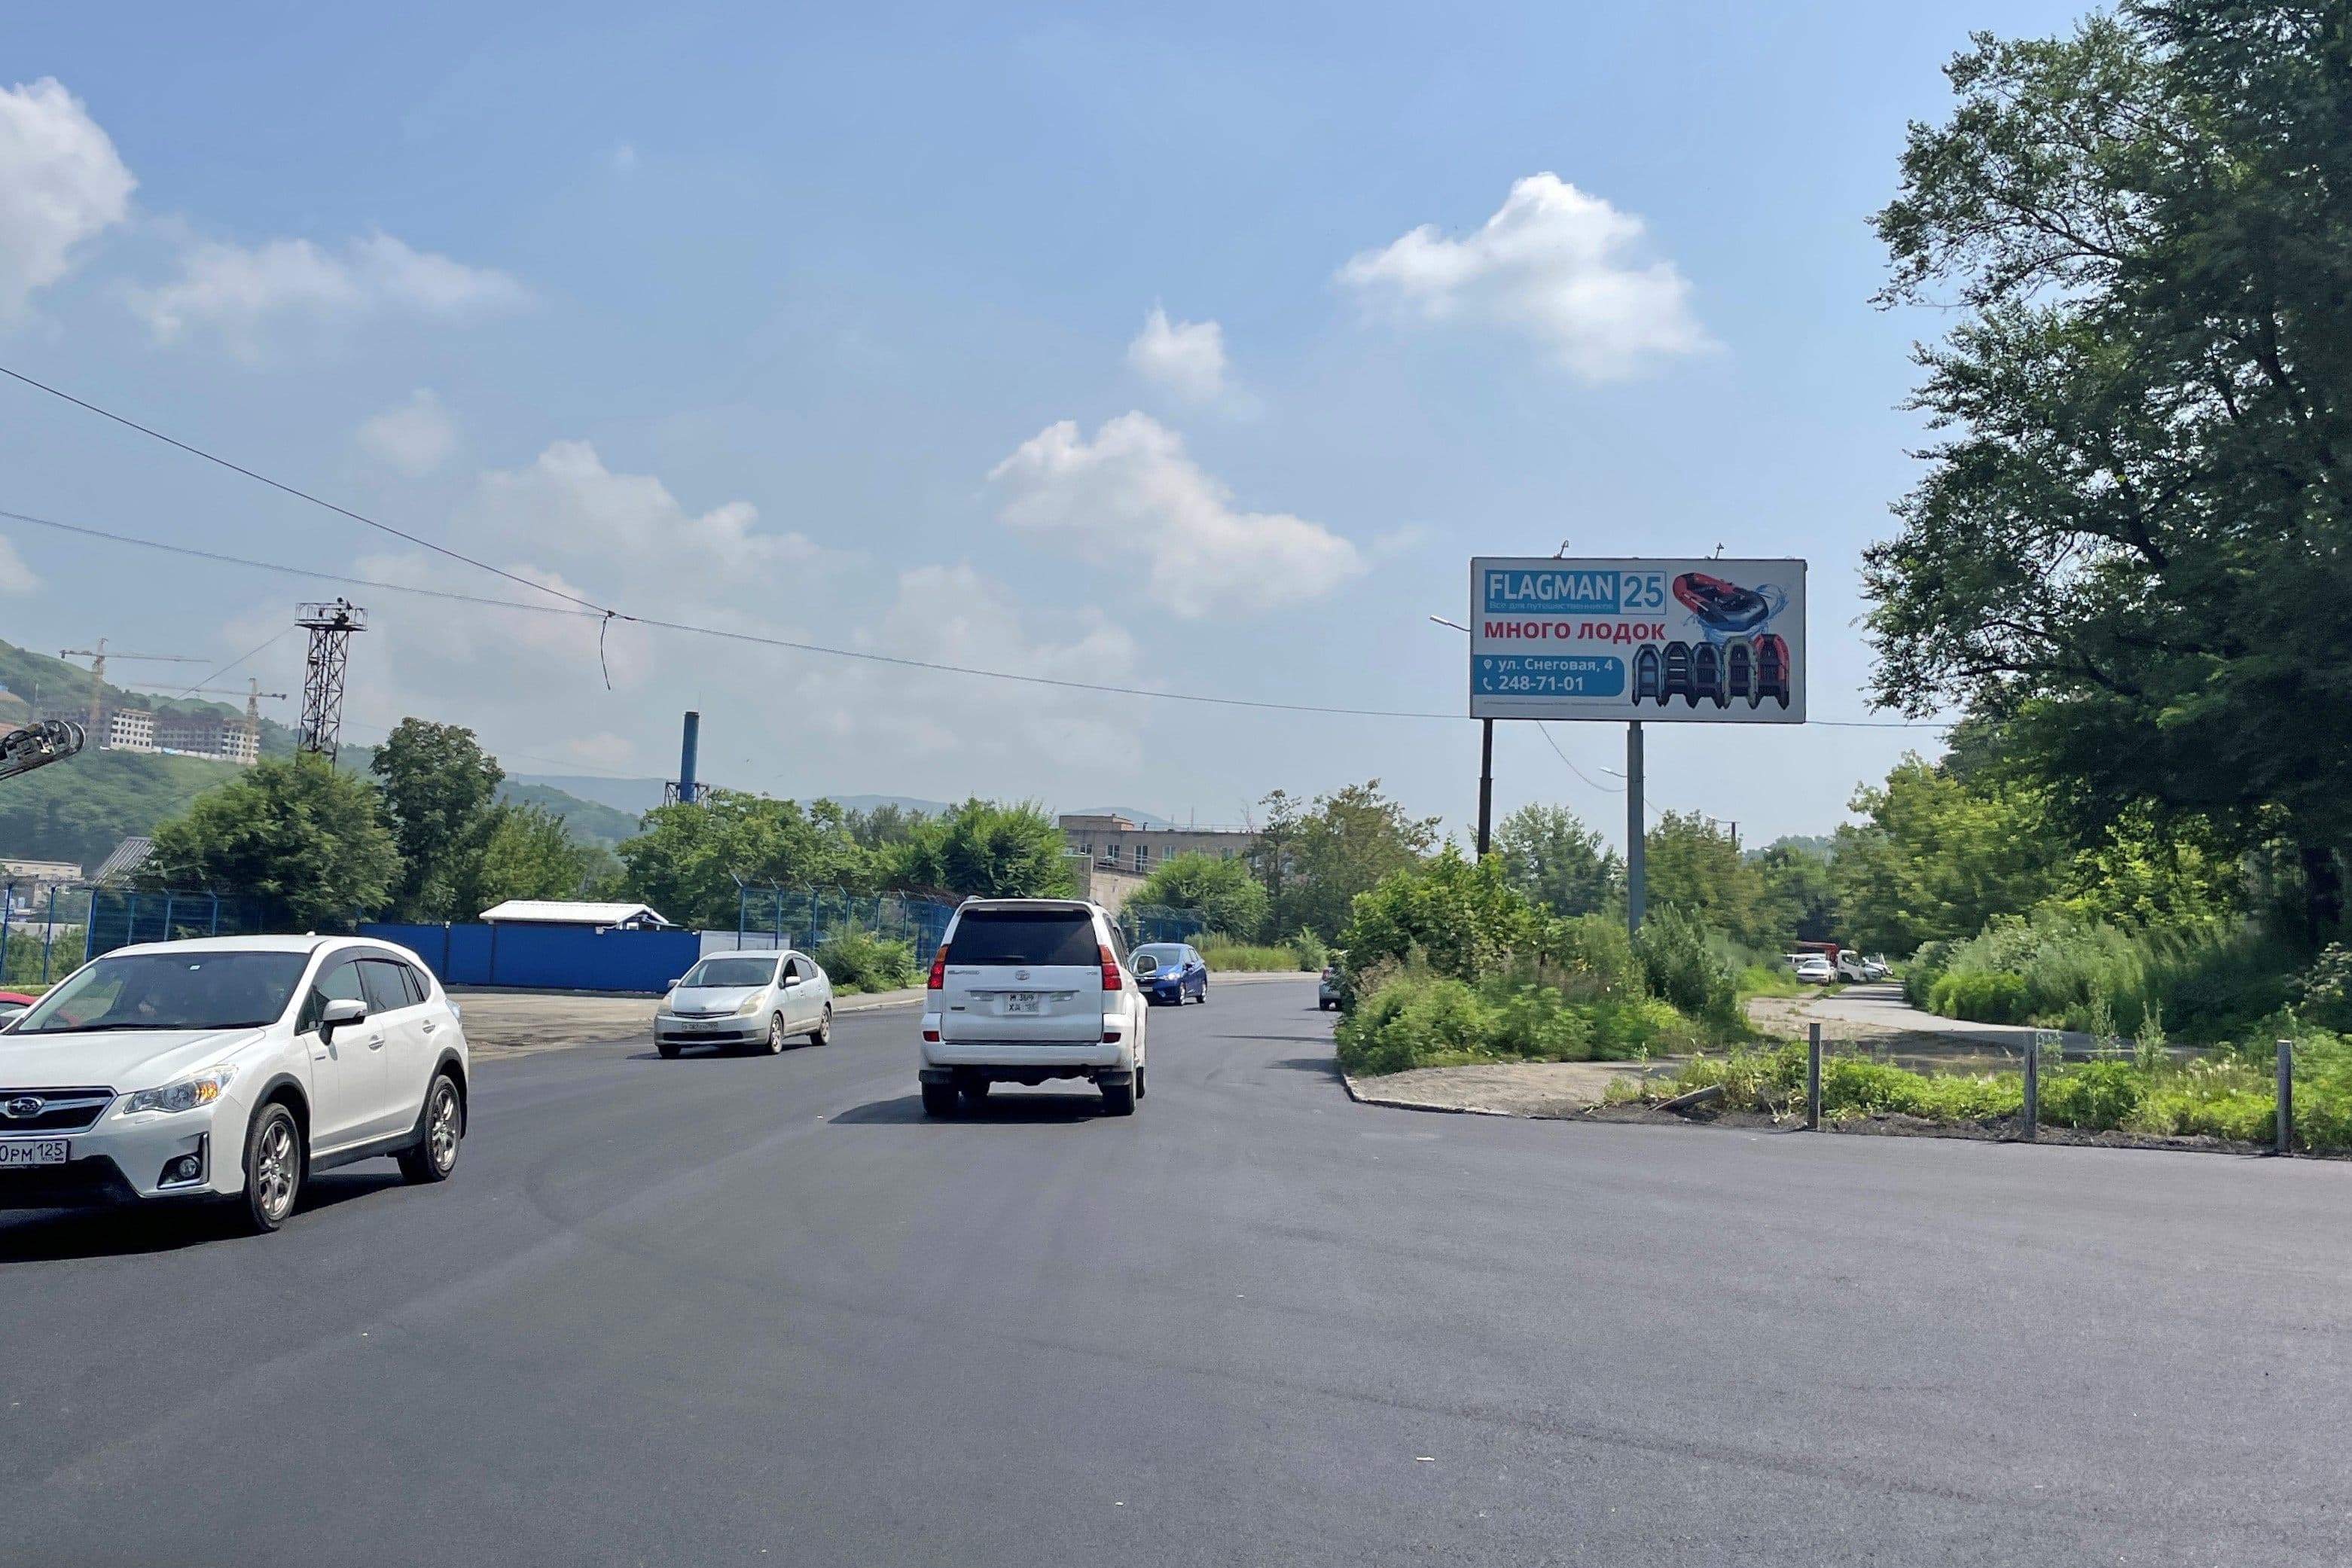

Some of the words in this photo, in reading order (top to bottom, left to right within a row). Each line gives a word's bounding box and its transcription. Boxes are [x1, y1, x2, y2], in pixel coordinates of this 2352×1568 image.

[1490, 574, 1613, 600] FLAGMAN
[1623, 576, 1664, 608] 25
[1485, 621, 1570, 639] МНОГО
[1578, 623, 1666, 644] ЛОДОК
[1498, 660, 1521, 673] ул.
[1524, 658, 1600, 673] Снеговая,
[1604, 659, 1613, 671] 4
[1498, 675, 1583, 691] 248-71-01
[37, 1142, 63, 1156] 125
